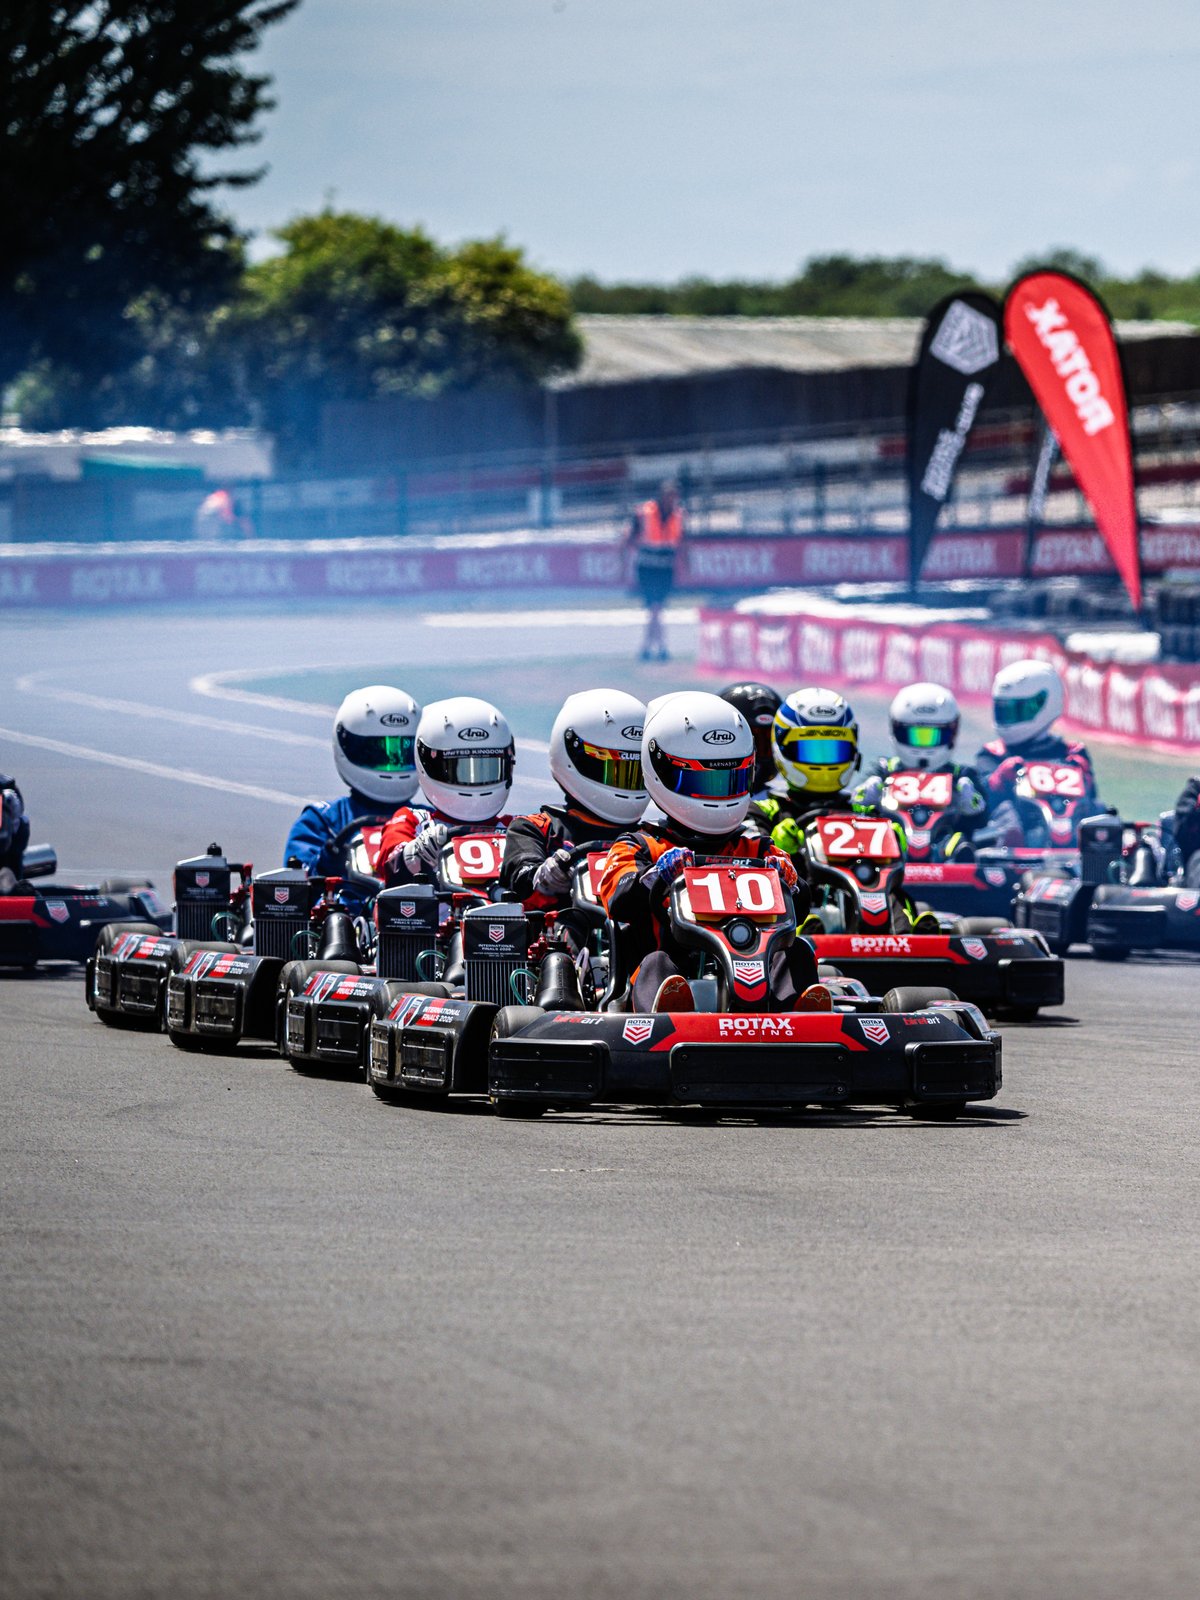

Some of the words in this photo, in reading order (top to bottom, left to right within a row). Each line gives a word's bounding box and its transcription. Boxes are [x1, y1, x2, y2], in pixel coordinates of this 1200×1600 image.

[1025, 298, 1116, 436] ROTAX
[894, 775, 951, 804] 34
[1027, 764, 1082, 796] 62
[823, 821, 890, 858] 27
[459, 840, 505, 875] 9
[692, 872, 775, 911] 10
[850, 937, 909, 948] ROTAX
[718, 1018, 791, 1030] ROTAX
